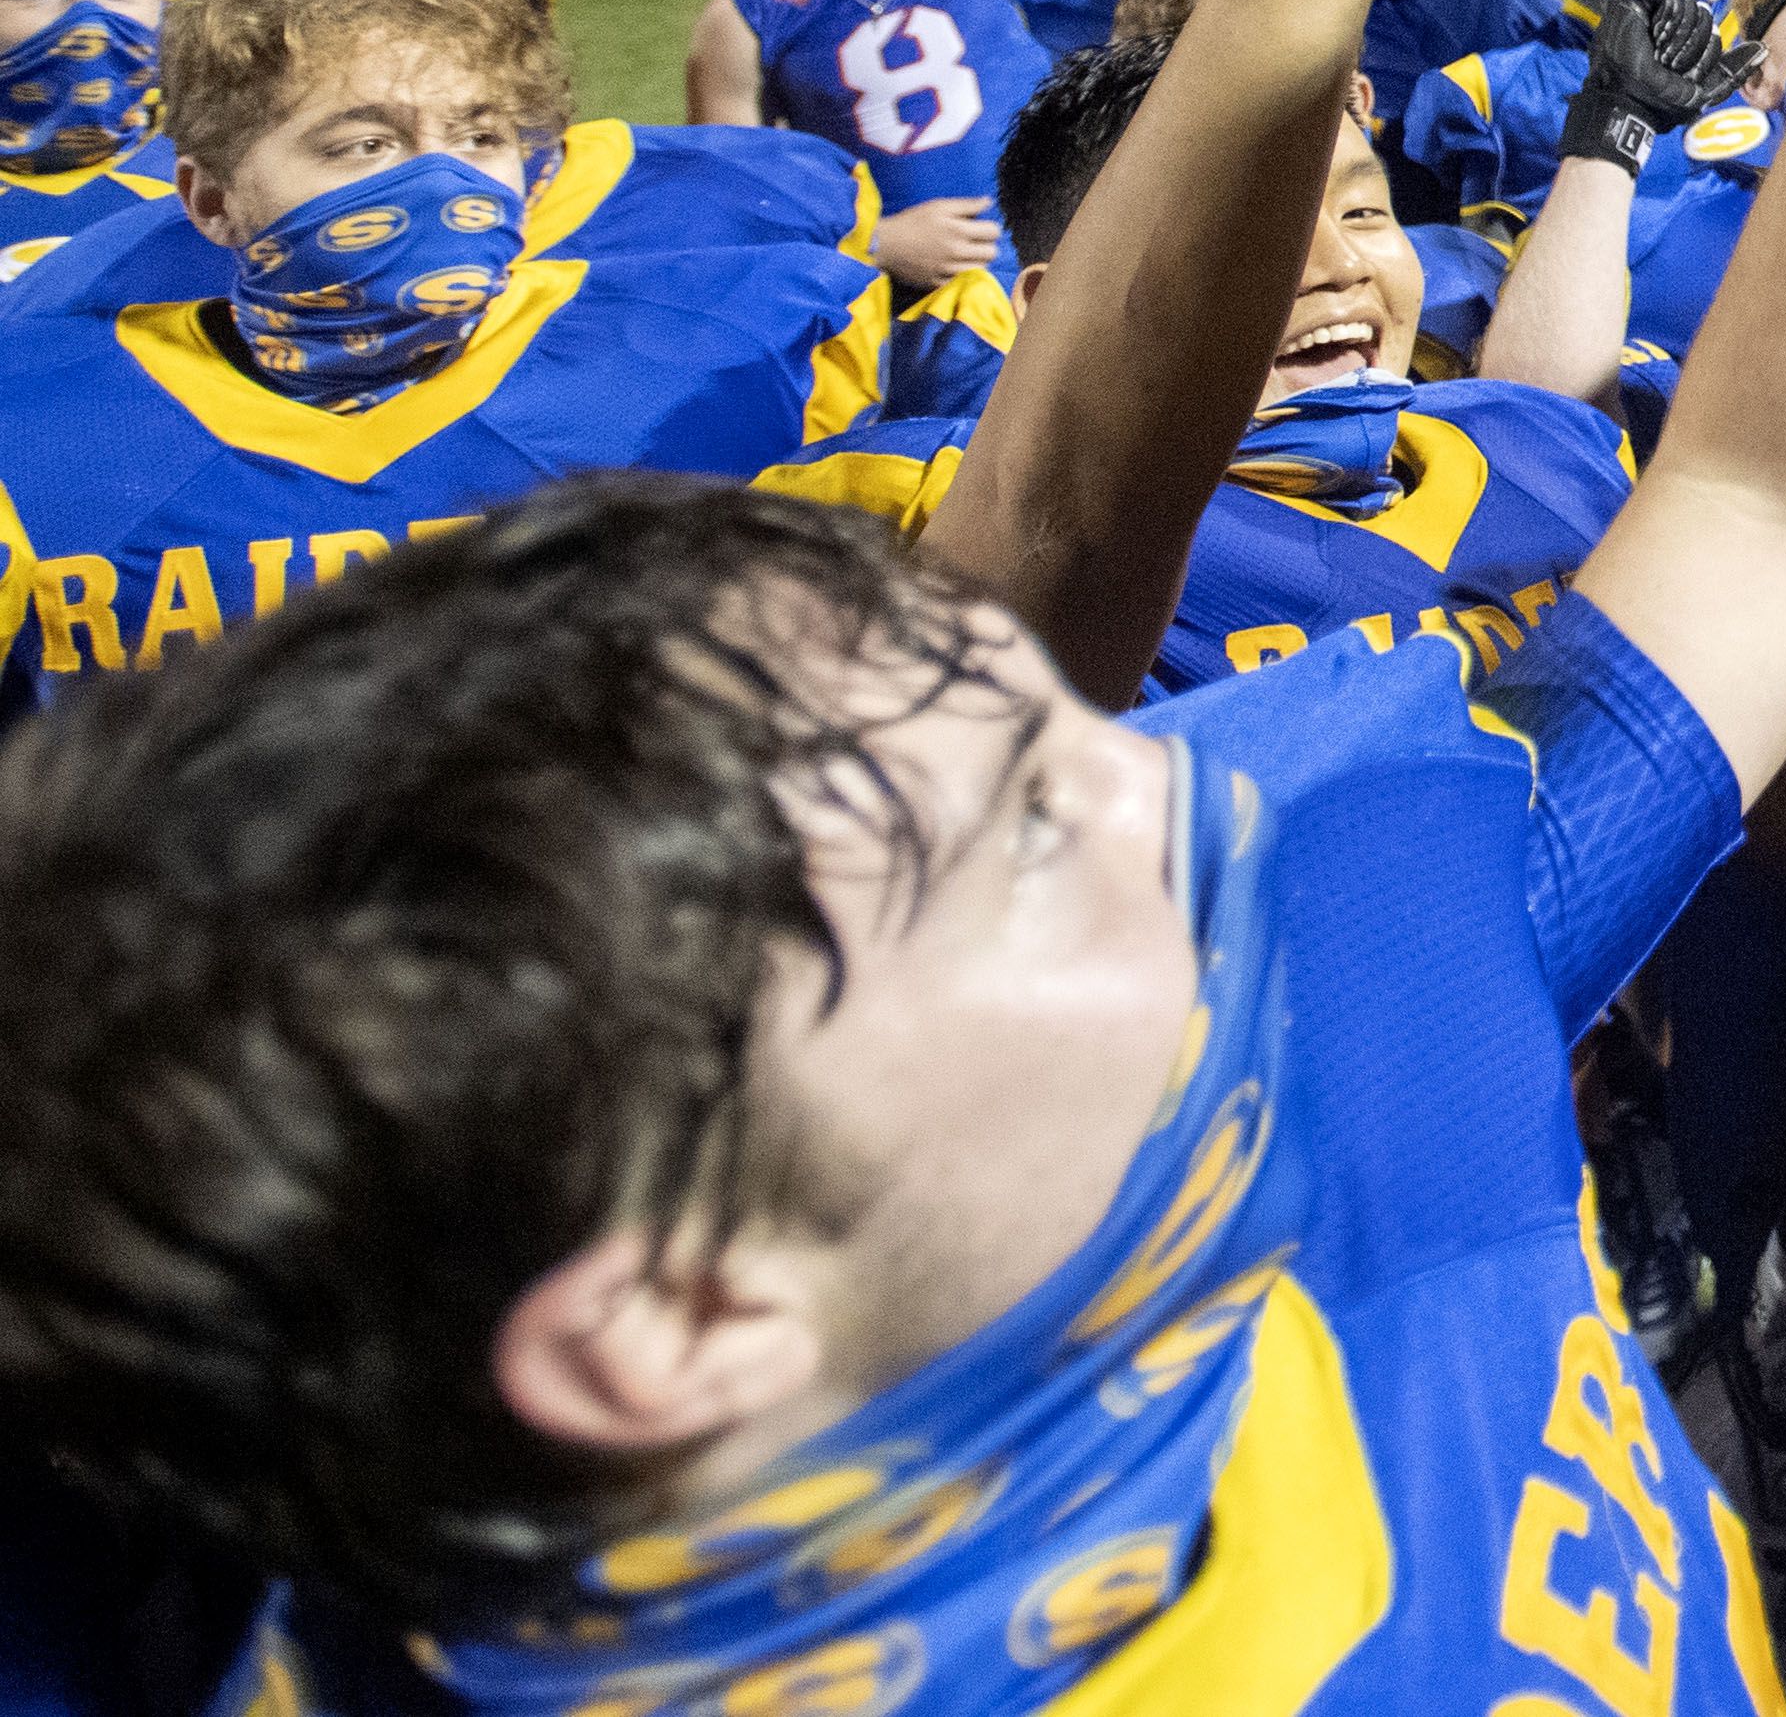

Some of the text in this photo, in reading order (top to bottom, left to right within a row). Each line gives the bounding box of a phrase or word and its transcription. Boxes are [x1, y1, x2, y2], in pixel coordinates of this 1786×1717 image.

[839, 5, 983, 156] 8
[328, 211, 396, 248] S
[411, 270, 487, 316] S
